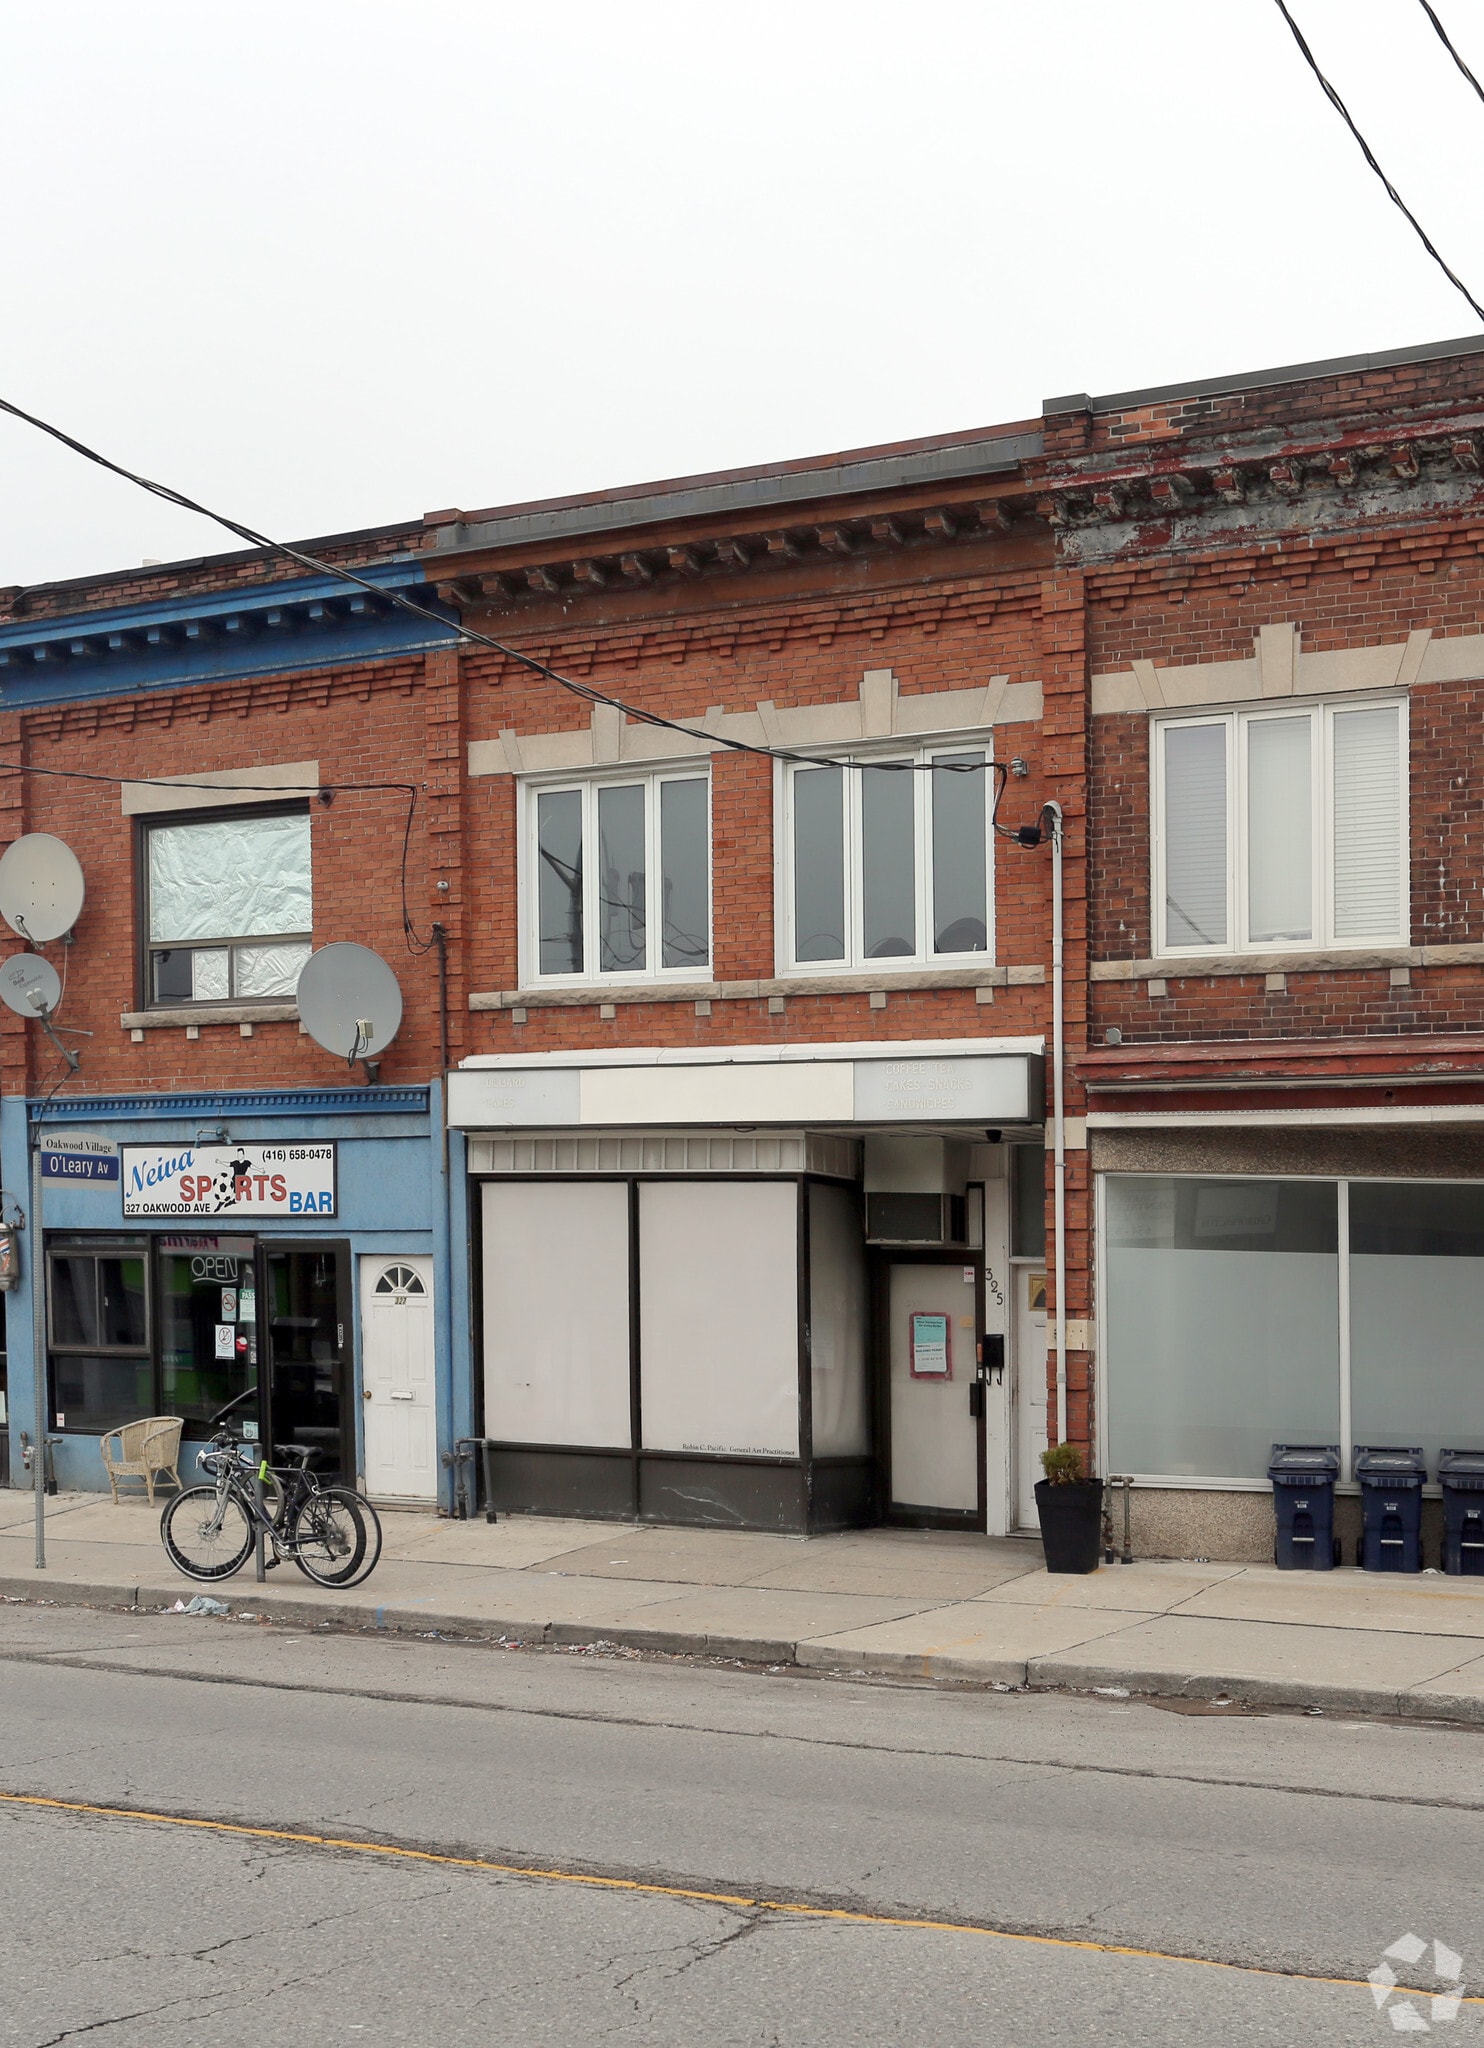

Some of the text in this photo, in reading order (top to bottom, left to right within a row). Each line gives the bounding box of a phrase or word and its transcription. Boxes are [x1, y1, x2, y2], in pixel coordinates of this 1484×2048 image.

[46, 1139, 112, 1154] Oakwood Village
[262, 1149, 332, 1162] (416) 658-0478
[50, 1155, 109, 1177] O'Leary Av
[126, 1150, 195, 1198] Neiva
[126, 1203, 211, 1213] 327 OAKWOOD AVE
[290, 1192, 332, 1212] BAR
[191, 1256, 238, 1278] OPEN
[985, 1267, 1004, 1306] 325
[763, 1447, 795, 1456] Practitioner
